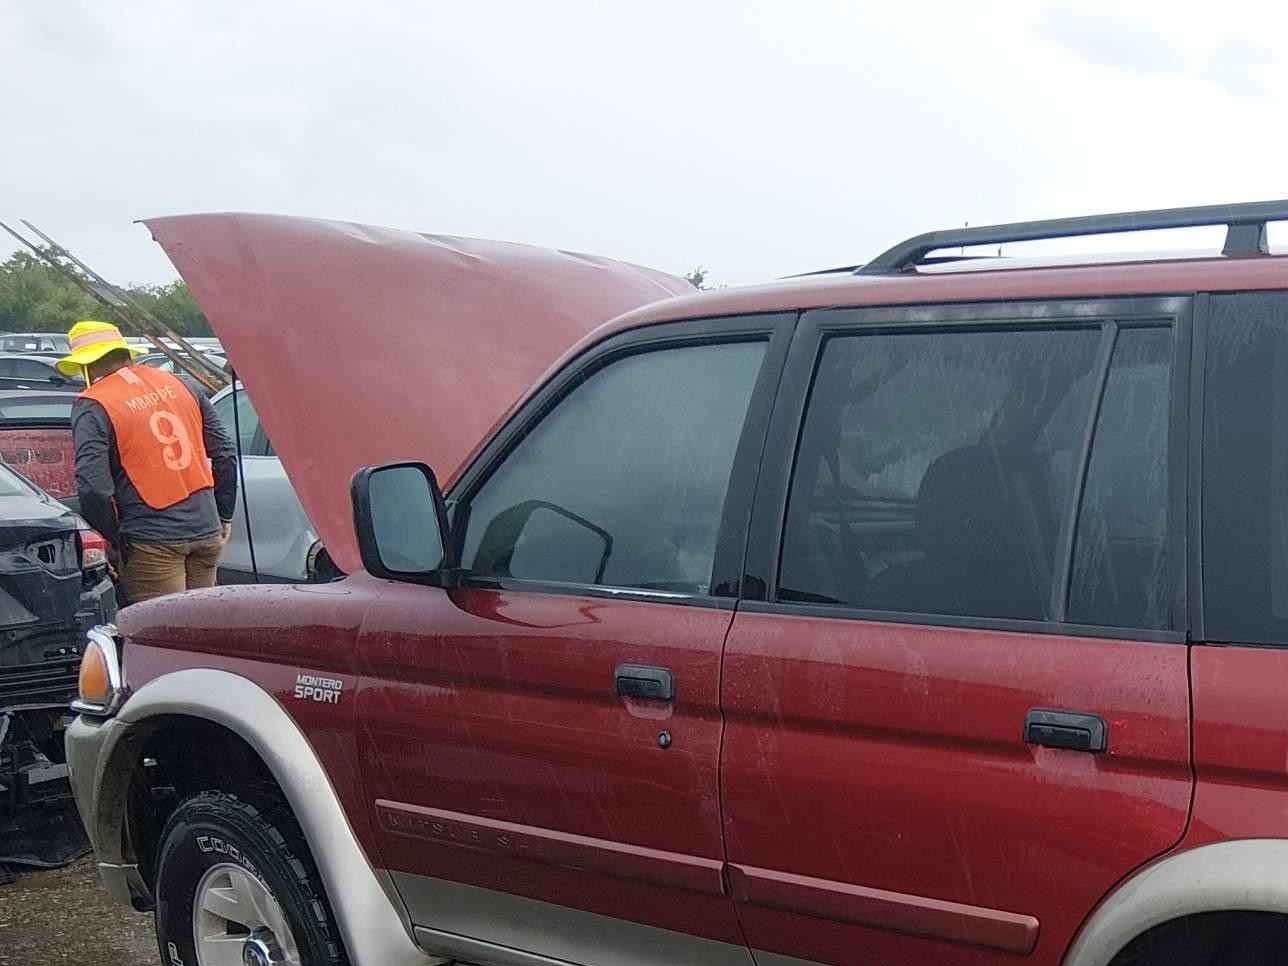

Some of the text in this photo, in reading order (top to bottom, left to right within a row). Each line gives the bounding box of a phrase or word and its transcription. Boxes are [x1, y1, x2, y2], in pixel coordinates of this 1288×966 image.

[149, 410, 192, 471] 9
[296, 674, 343, 690] MONTERO
[294, 685, 341, 705] SPORT
